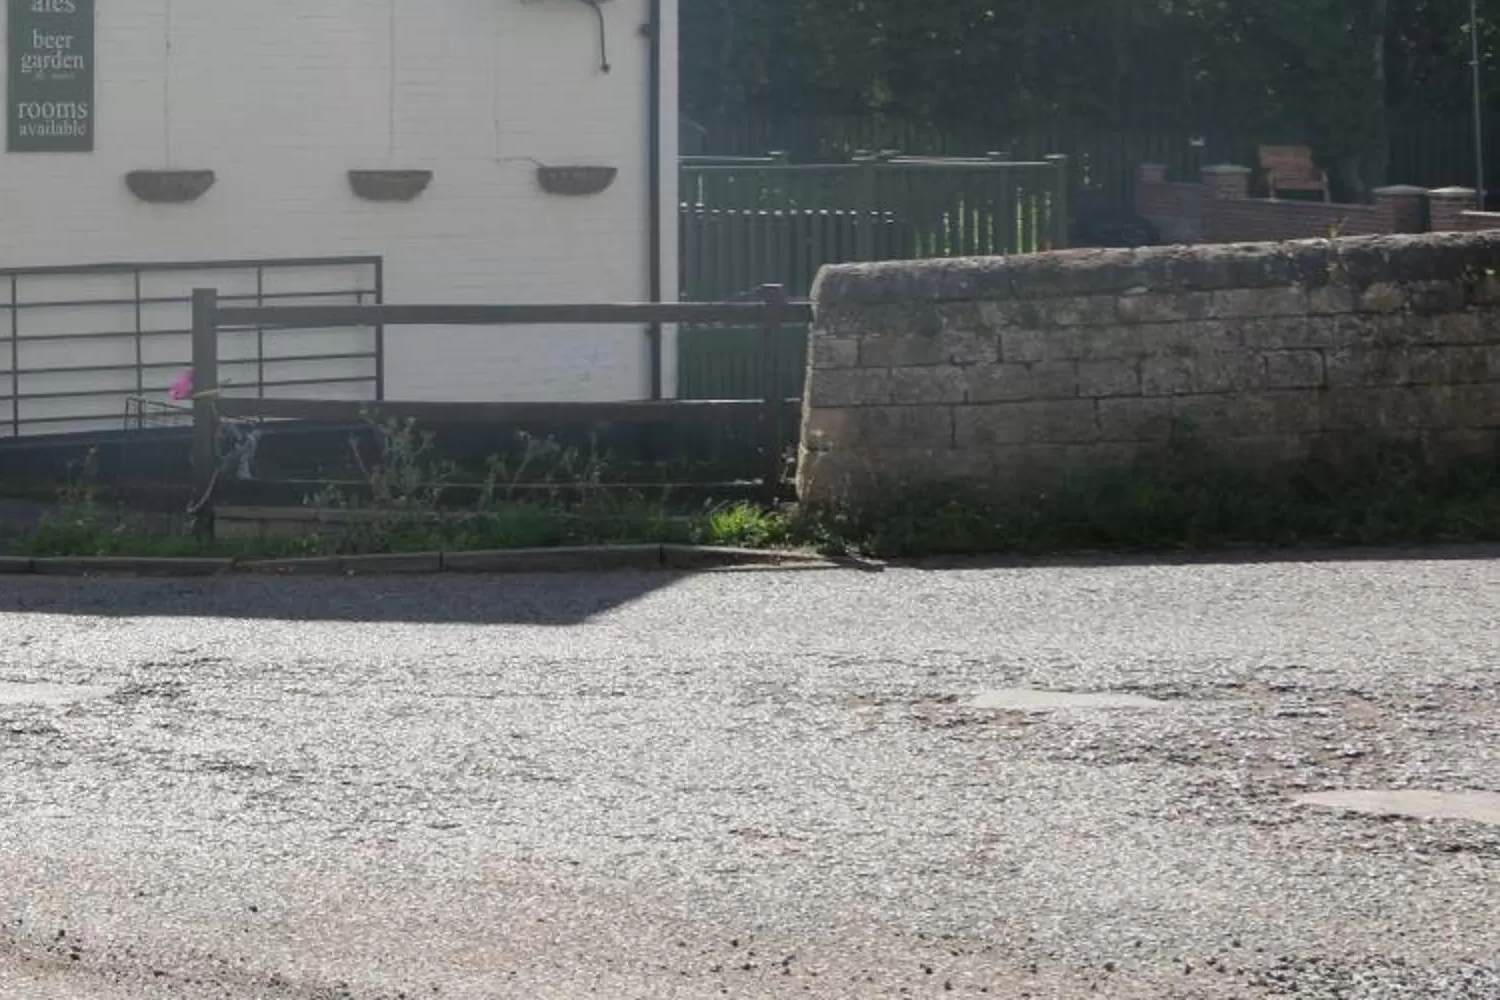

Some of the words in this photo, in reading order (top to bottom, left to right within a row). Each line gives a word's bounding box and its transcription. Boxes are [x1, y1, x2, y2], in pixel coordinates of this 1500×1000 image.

[33, 28, 74, 49] beer
[21, 50, 84, 73] garden
[18, 102, 88, 119] rooms
[19, 119, 86, 137] available
